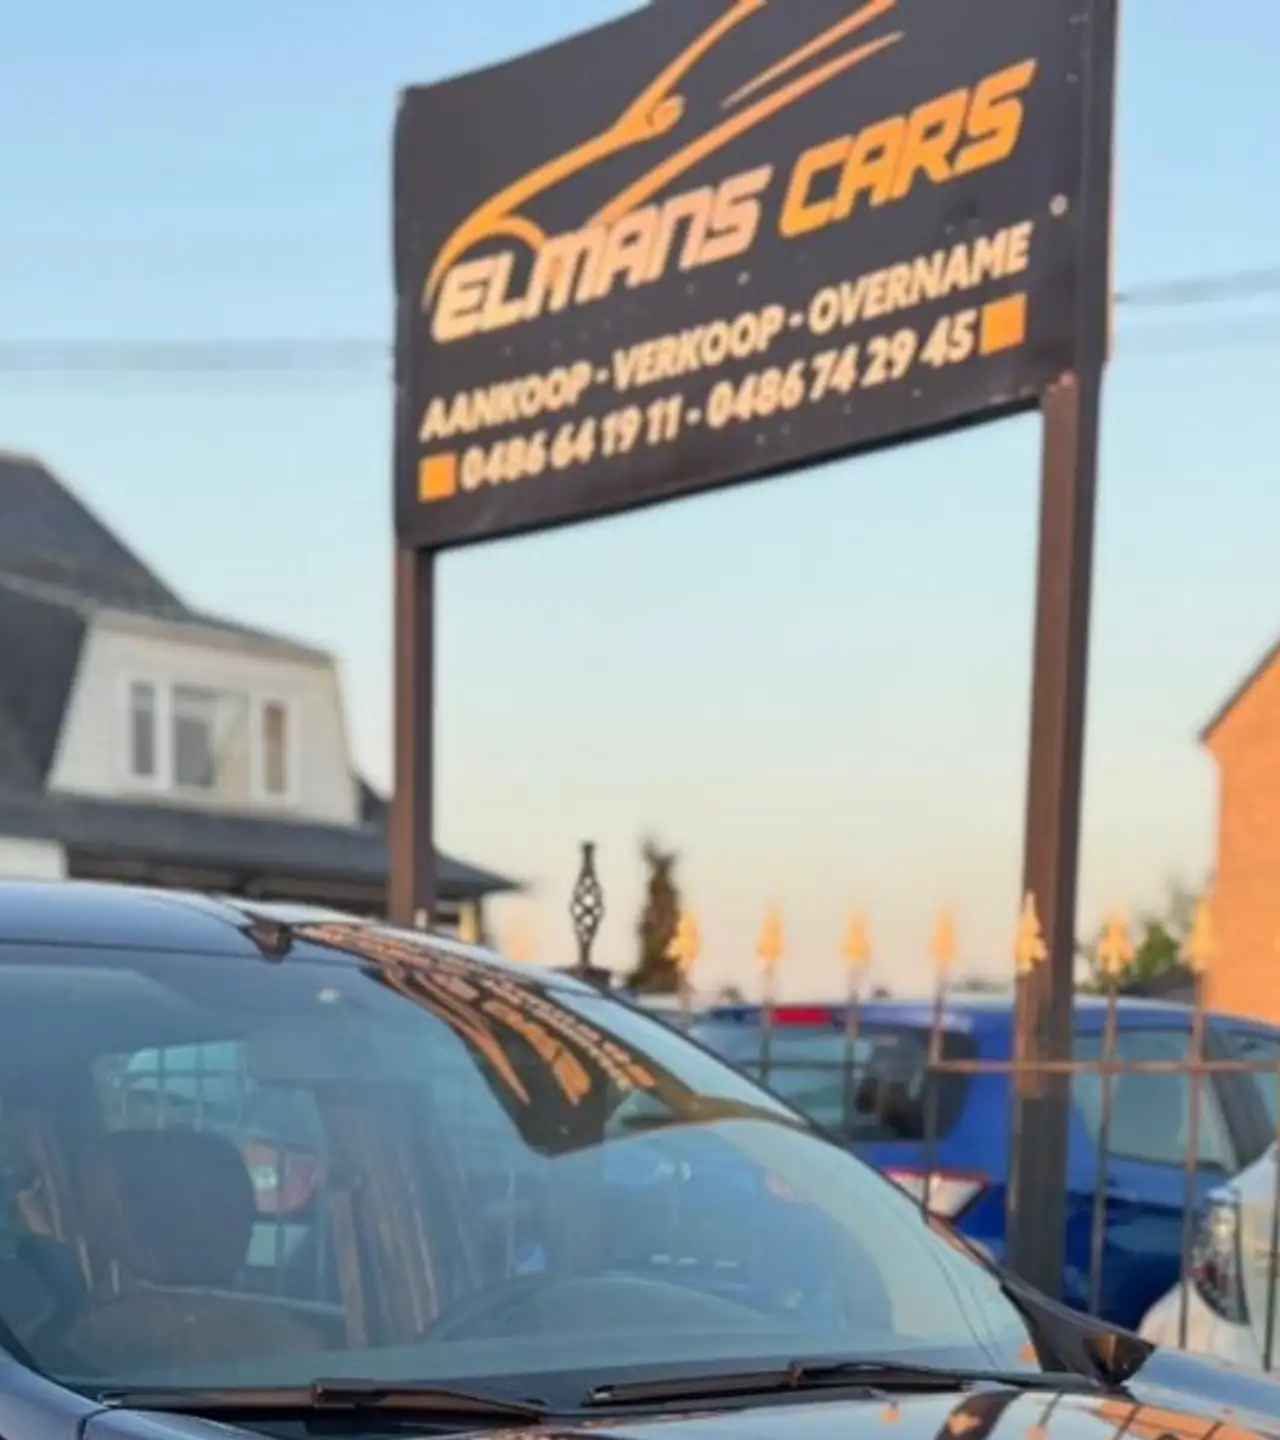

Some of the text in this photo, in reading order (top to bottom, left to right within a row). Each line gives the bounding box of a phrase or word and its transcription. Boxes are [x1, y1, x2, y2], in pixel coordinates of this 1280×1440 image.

[778, 58, 1038, 238] CARS
[418, 360, 592, 442] AANKOOP
[613, 303, 785, 392] VERKOOP
[808, 219, 1034, 335] OVERNAME
[460, 430, 548, 491] 0486
[551, 417, 597, 469] 64
[601, 404, 642, 456] 19
[646, 394, 683, 445] 11
[706, 359, 805, 428] 0486
[809, 342, 859, 403] 74
[860, 328, 917, 389] 29
[919, 308, 978, 368] 45
